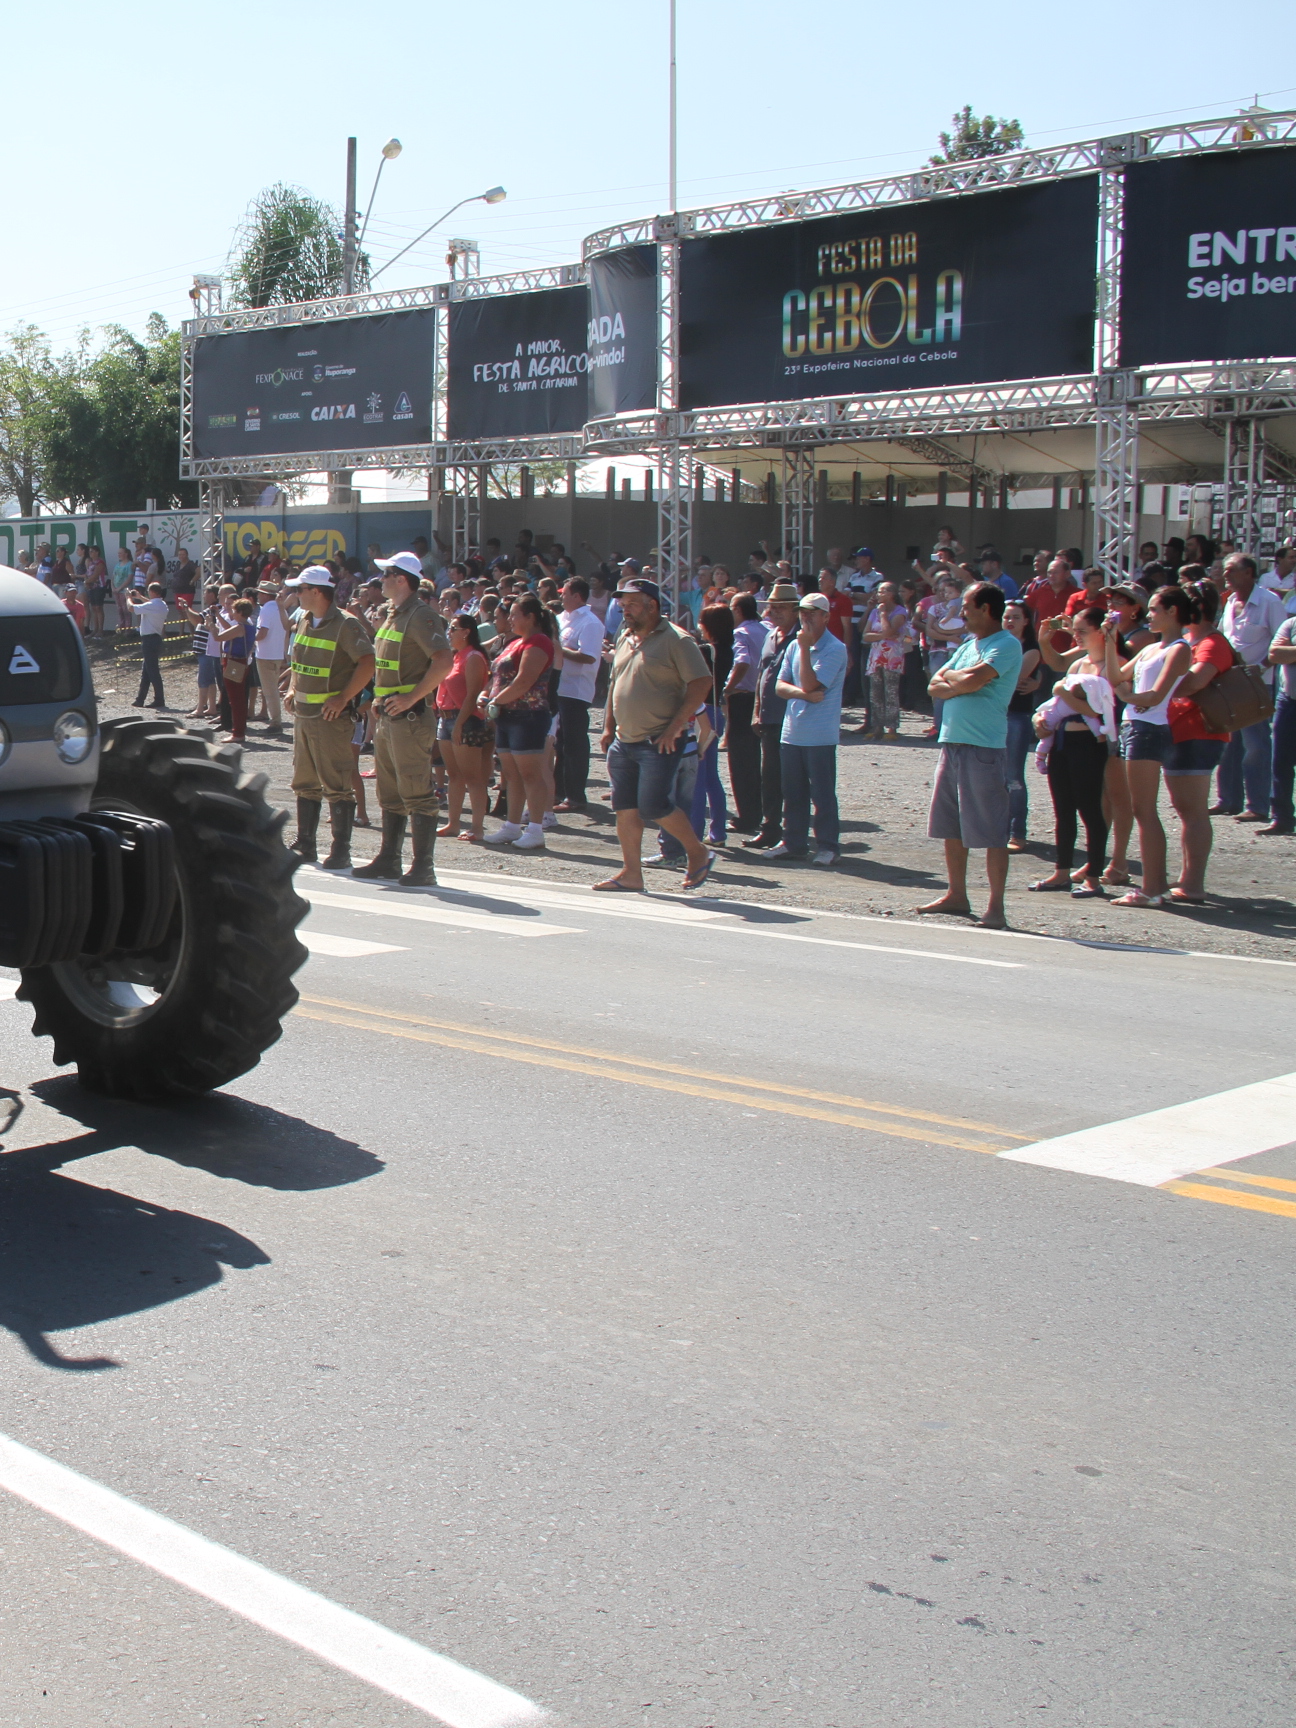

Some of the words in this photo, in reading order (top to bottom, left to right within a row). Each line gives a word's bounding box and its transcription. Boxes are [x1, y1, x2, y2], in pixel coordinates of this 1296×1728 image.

[818, 235, 883, 277] FESTA
[890, 231, 918, 268] DA
[1187, 273, 1246, 303] Seja
[782, 268, 963, 358] CEBOLA
[515, 343, 523, 357] A
[527, 339, 566, 356] MAIOR,
[473, 359, 522, 383] FESTA
[803, 361, 851, 375] Expofeira
[854, 354, 900, 369] Nacional
[902, 354, 916, 364] da
[919, 350, 958, 363] Cebola
[498, 382, 510, 393] DE
[513, 379, 538, 393] SANTA
[540, 376, 578, 390] CATARINA
[279, 412, 301, 420] CRESOL
[311, 404, 356, 421] CAIXA
